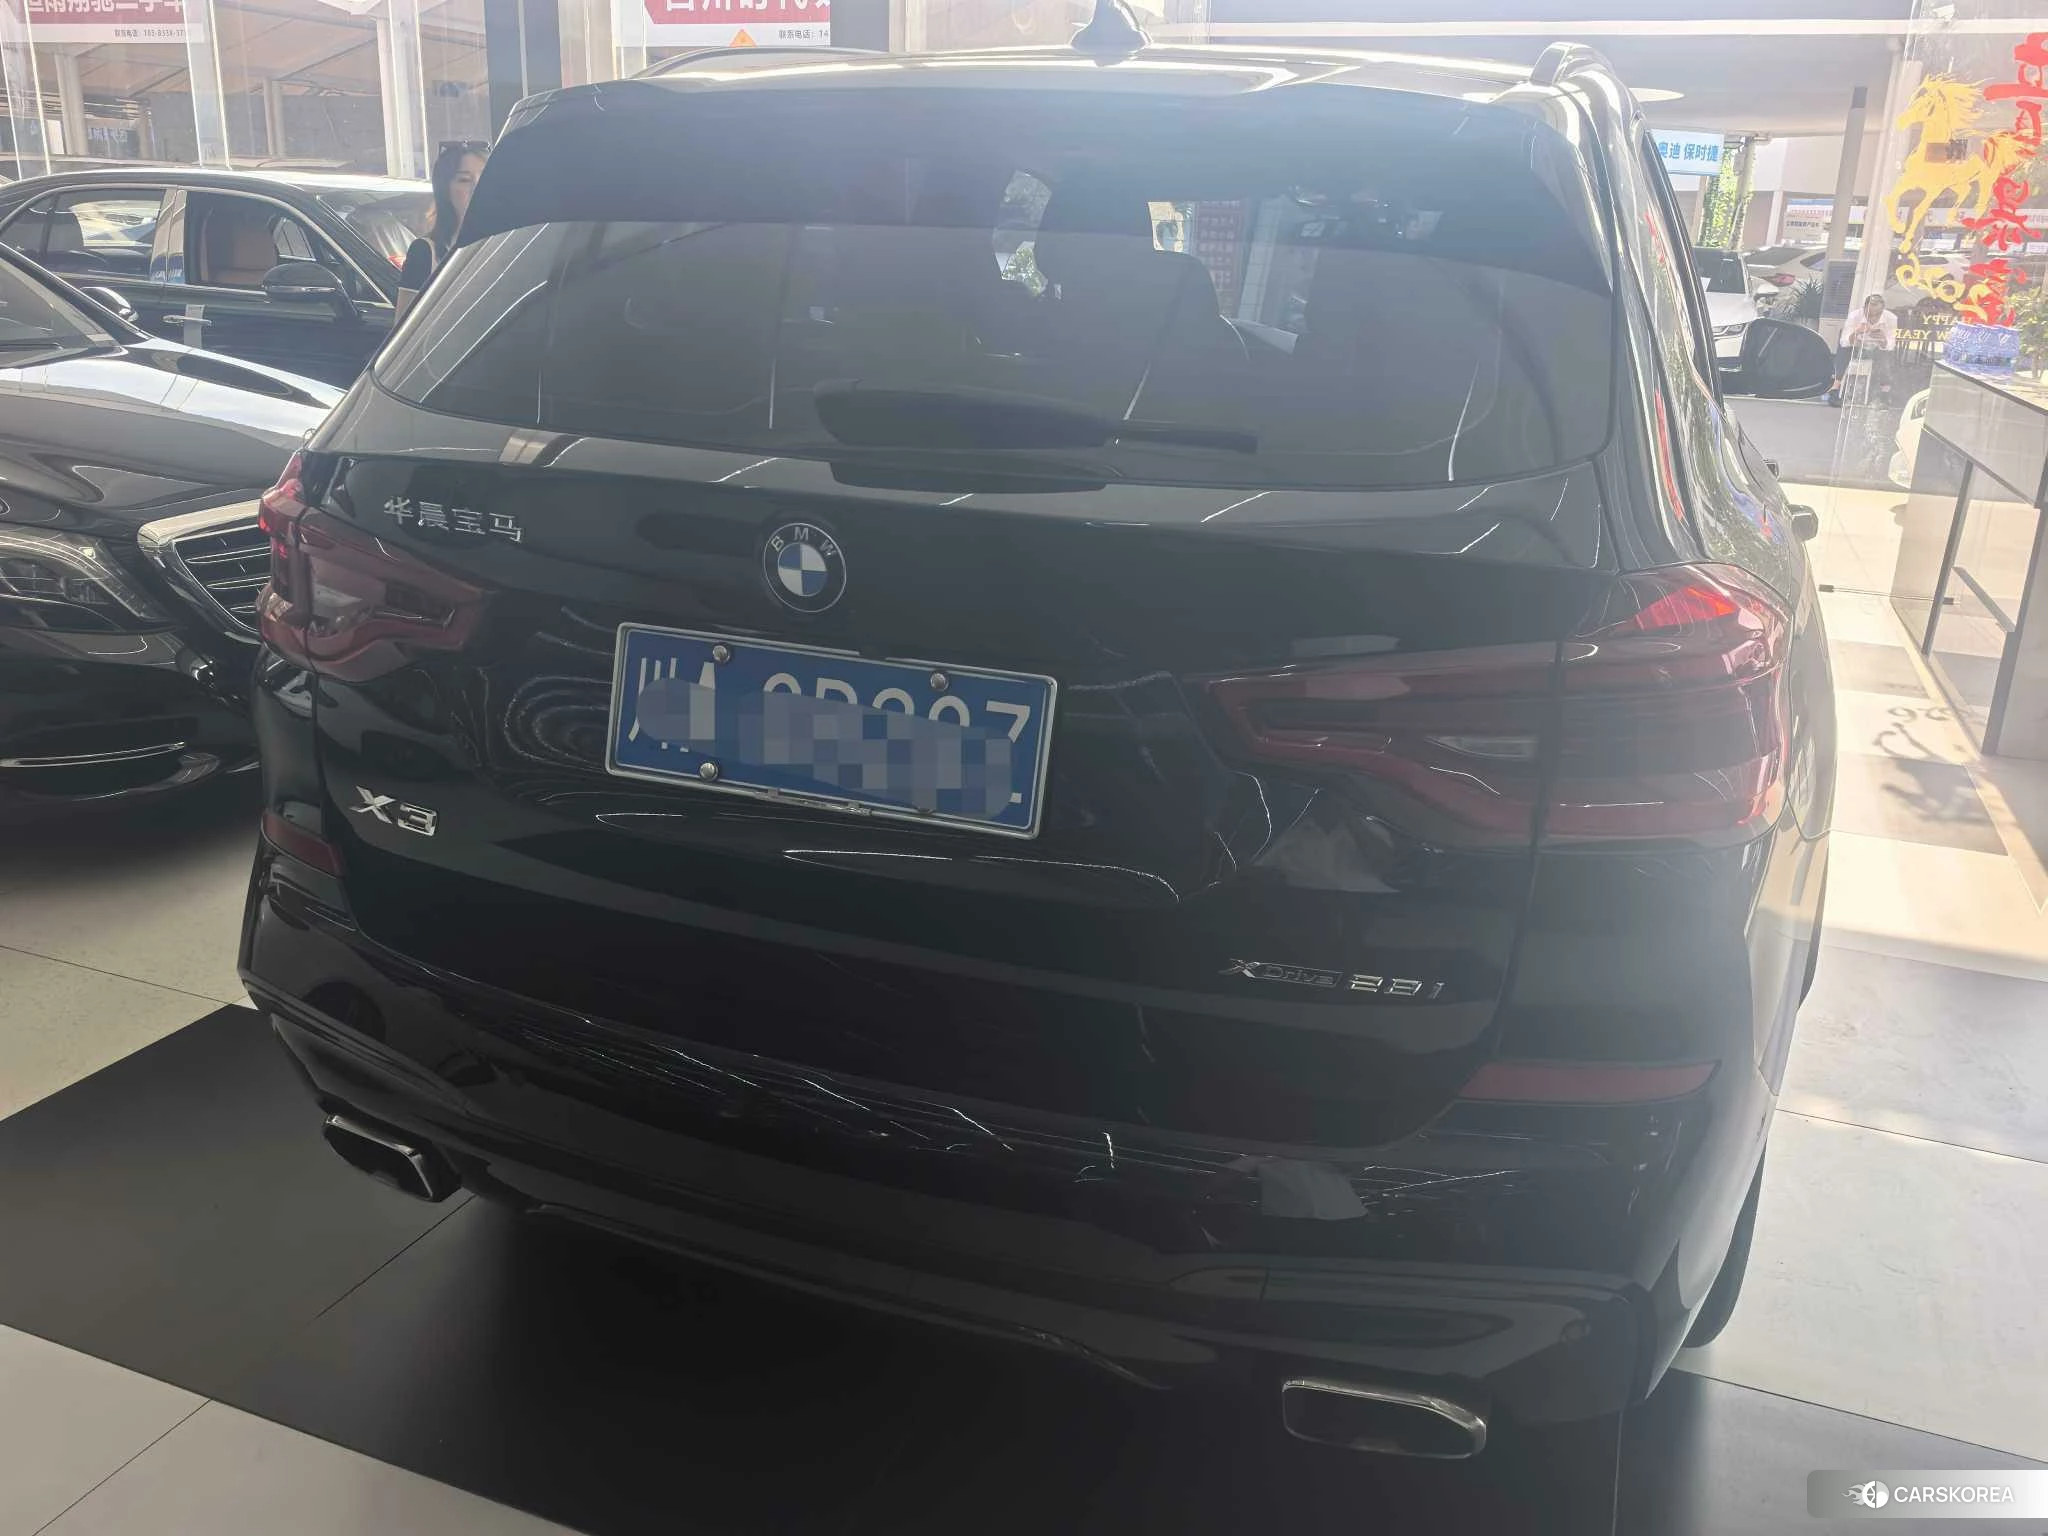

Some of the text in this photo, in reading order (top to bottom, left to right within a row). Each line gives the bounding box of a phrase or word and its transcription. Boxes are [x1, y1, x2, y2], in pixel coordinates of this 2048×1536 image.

[1683, 143, 1720, 162] 保时捷
[383, 496, 522, 543] 华晨宝马
[771, 526, 837, 558] BMW
[349, 786, 437, 837] X3
